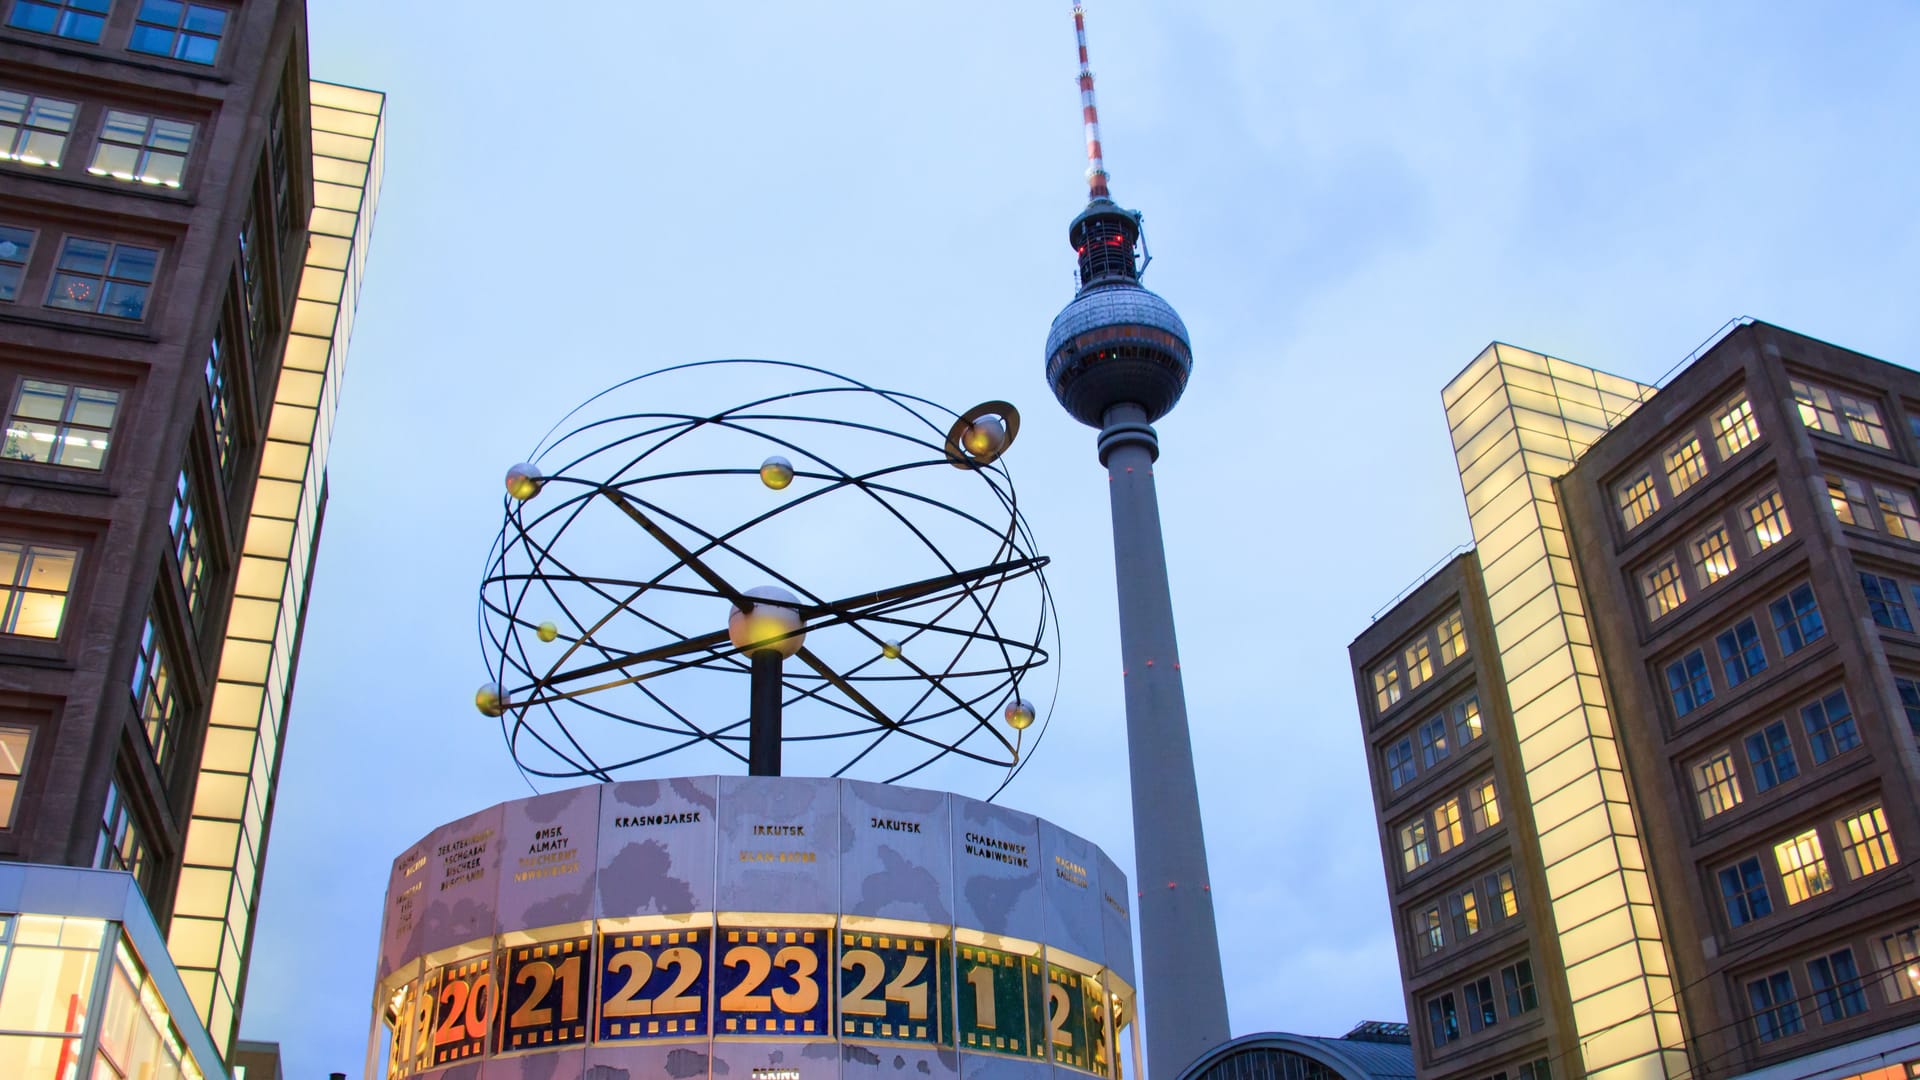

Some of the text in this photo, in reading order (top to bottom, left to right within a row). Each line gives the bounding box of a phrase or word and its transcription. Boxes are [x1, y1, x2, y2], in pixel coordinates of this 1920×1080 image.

[535, 826, 562, 840] OMSK
[615, 812, 701, 828] KRASNOJARSK
[753, 825, 805, 836] IRKUTSK
[871, 817, 921, 834] JAKUTSK
[528, 838, 569, 855] ALMATY
[965, 831, 1025, 854] CHABAROWSK
[965, 844, 1029, 868] WLADIWOSTOK
[510, 955, 582, 1029] 21
[602, 947, 703, 1018] 22
[720, 945, 819, 1014] 23
[840, 949, 928, 1020] 24
[967, 965, 997, 1030] 1
[434, 973, 500, 1046] 20
[1044, 982, 1073, 1047] 2
